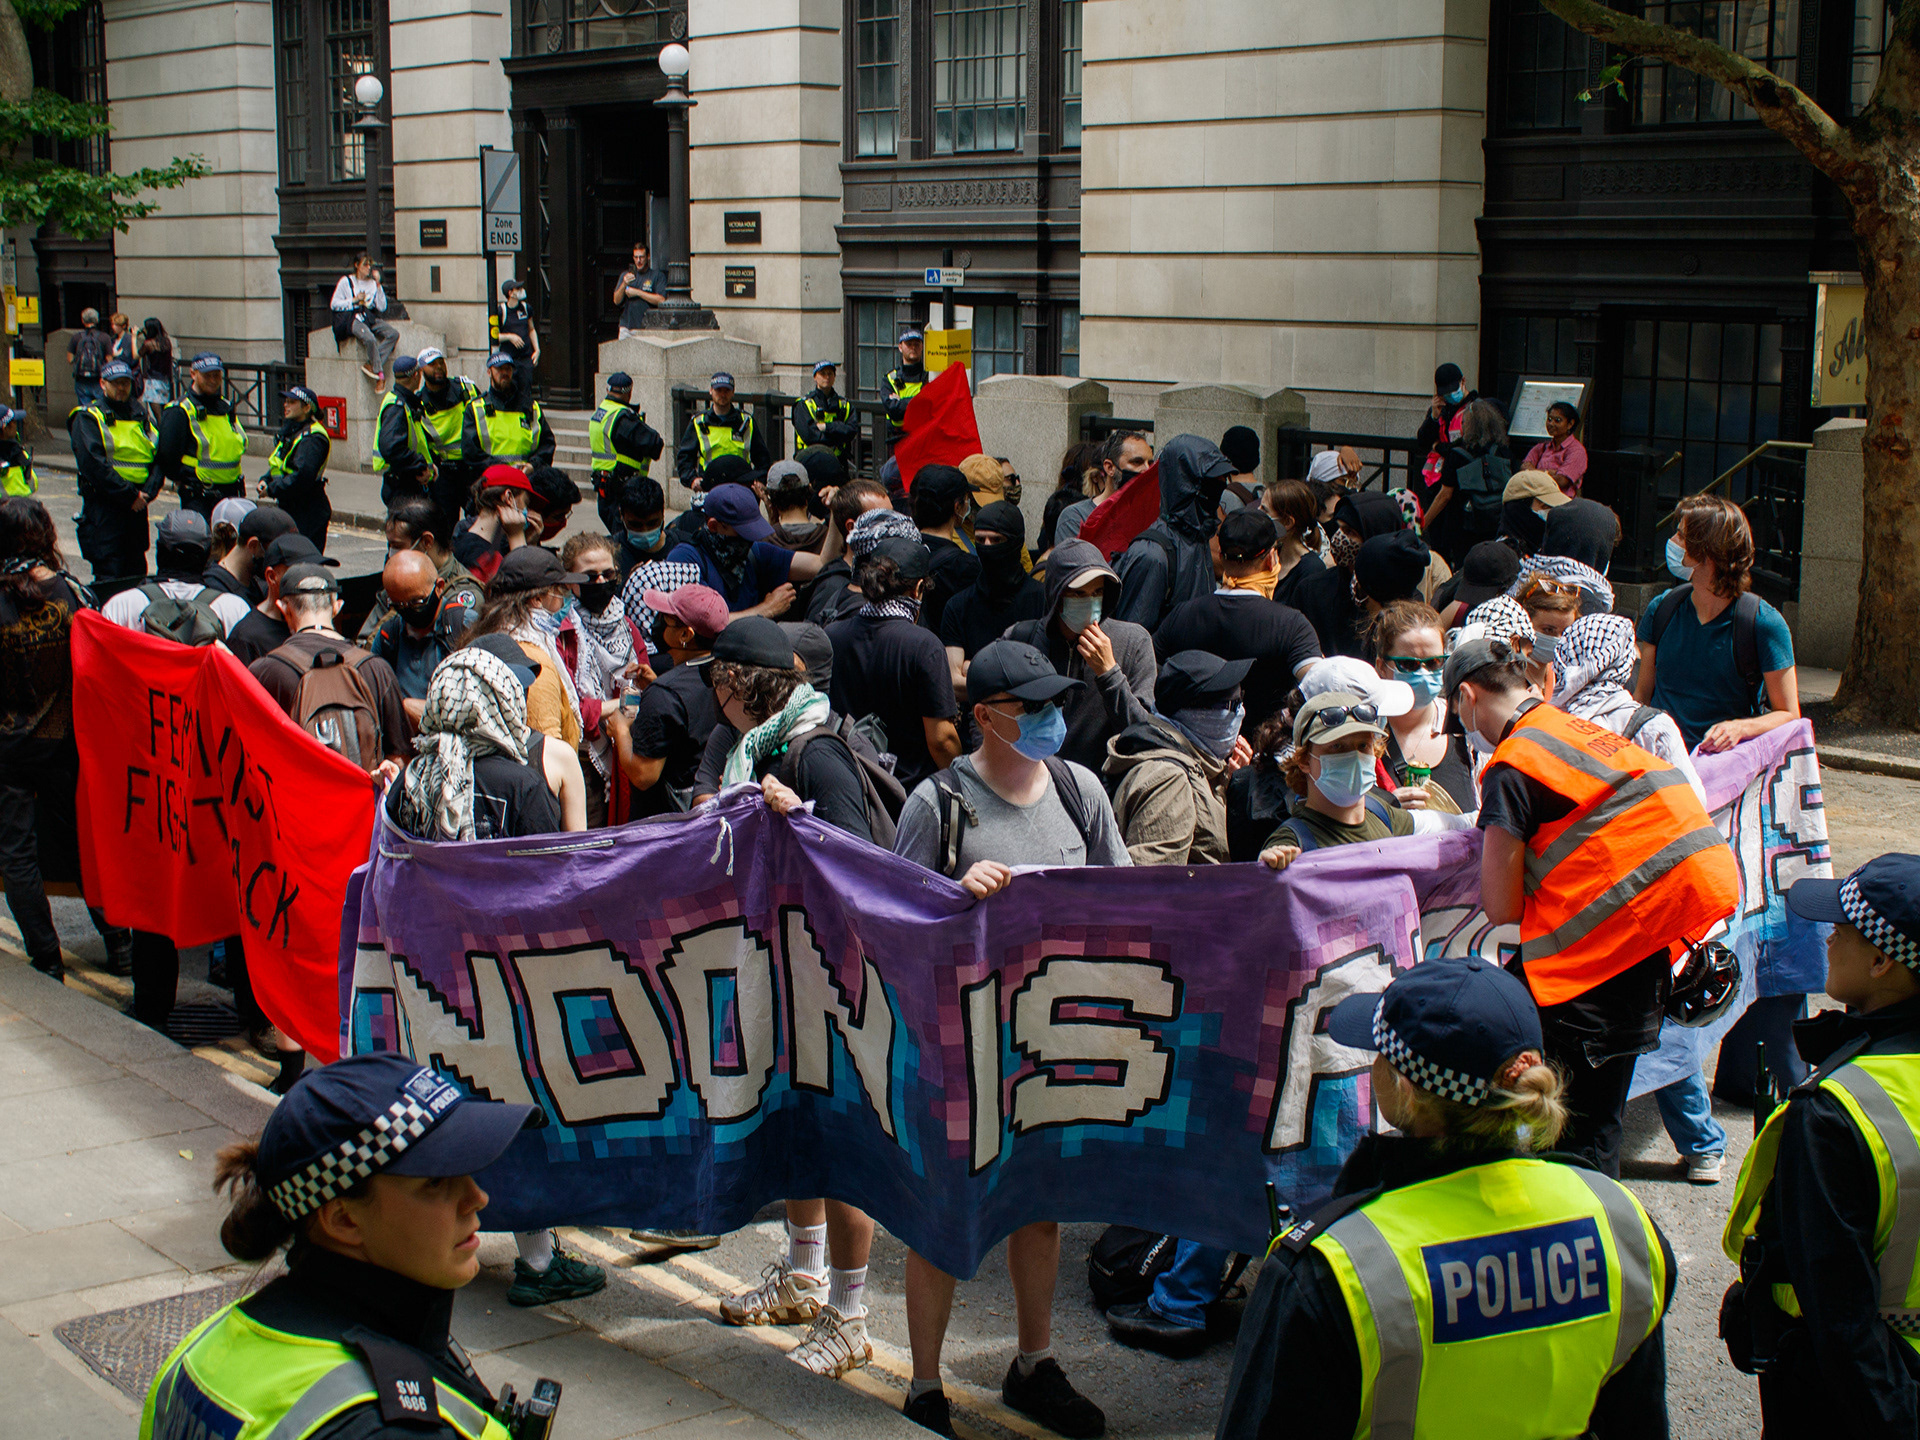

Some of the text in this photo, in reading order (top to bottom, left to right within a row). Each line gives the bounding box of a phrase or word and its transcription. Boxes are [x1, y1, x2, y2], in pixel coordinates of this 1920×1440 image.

[494, 217, 513, 228] Zone
[490, 231, 518, 245] ENDS
[942, 270, 962, 278] Loading
[231, 837, 299, 949] ACK
[960, 955, 1184, 1177] IS
[430, 1086, 461, 1114] POLICE
[1139, 1234, 1170, 1276] RMOUR
[1440, 1235, 1600, 1325] POLICE
[396, 1379, 420, 1395] SW
